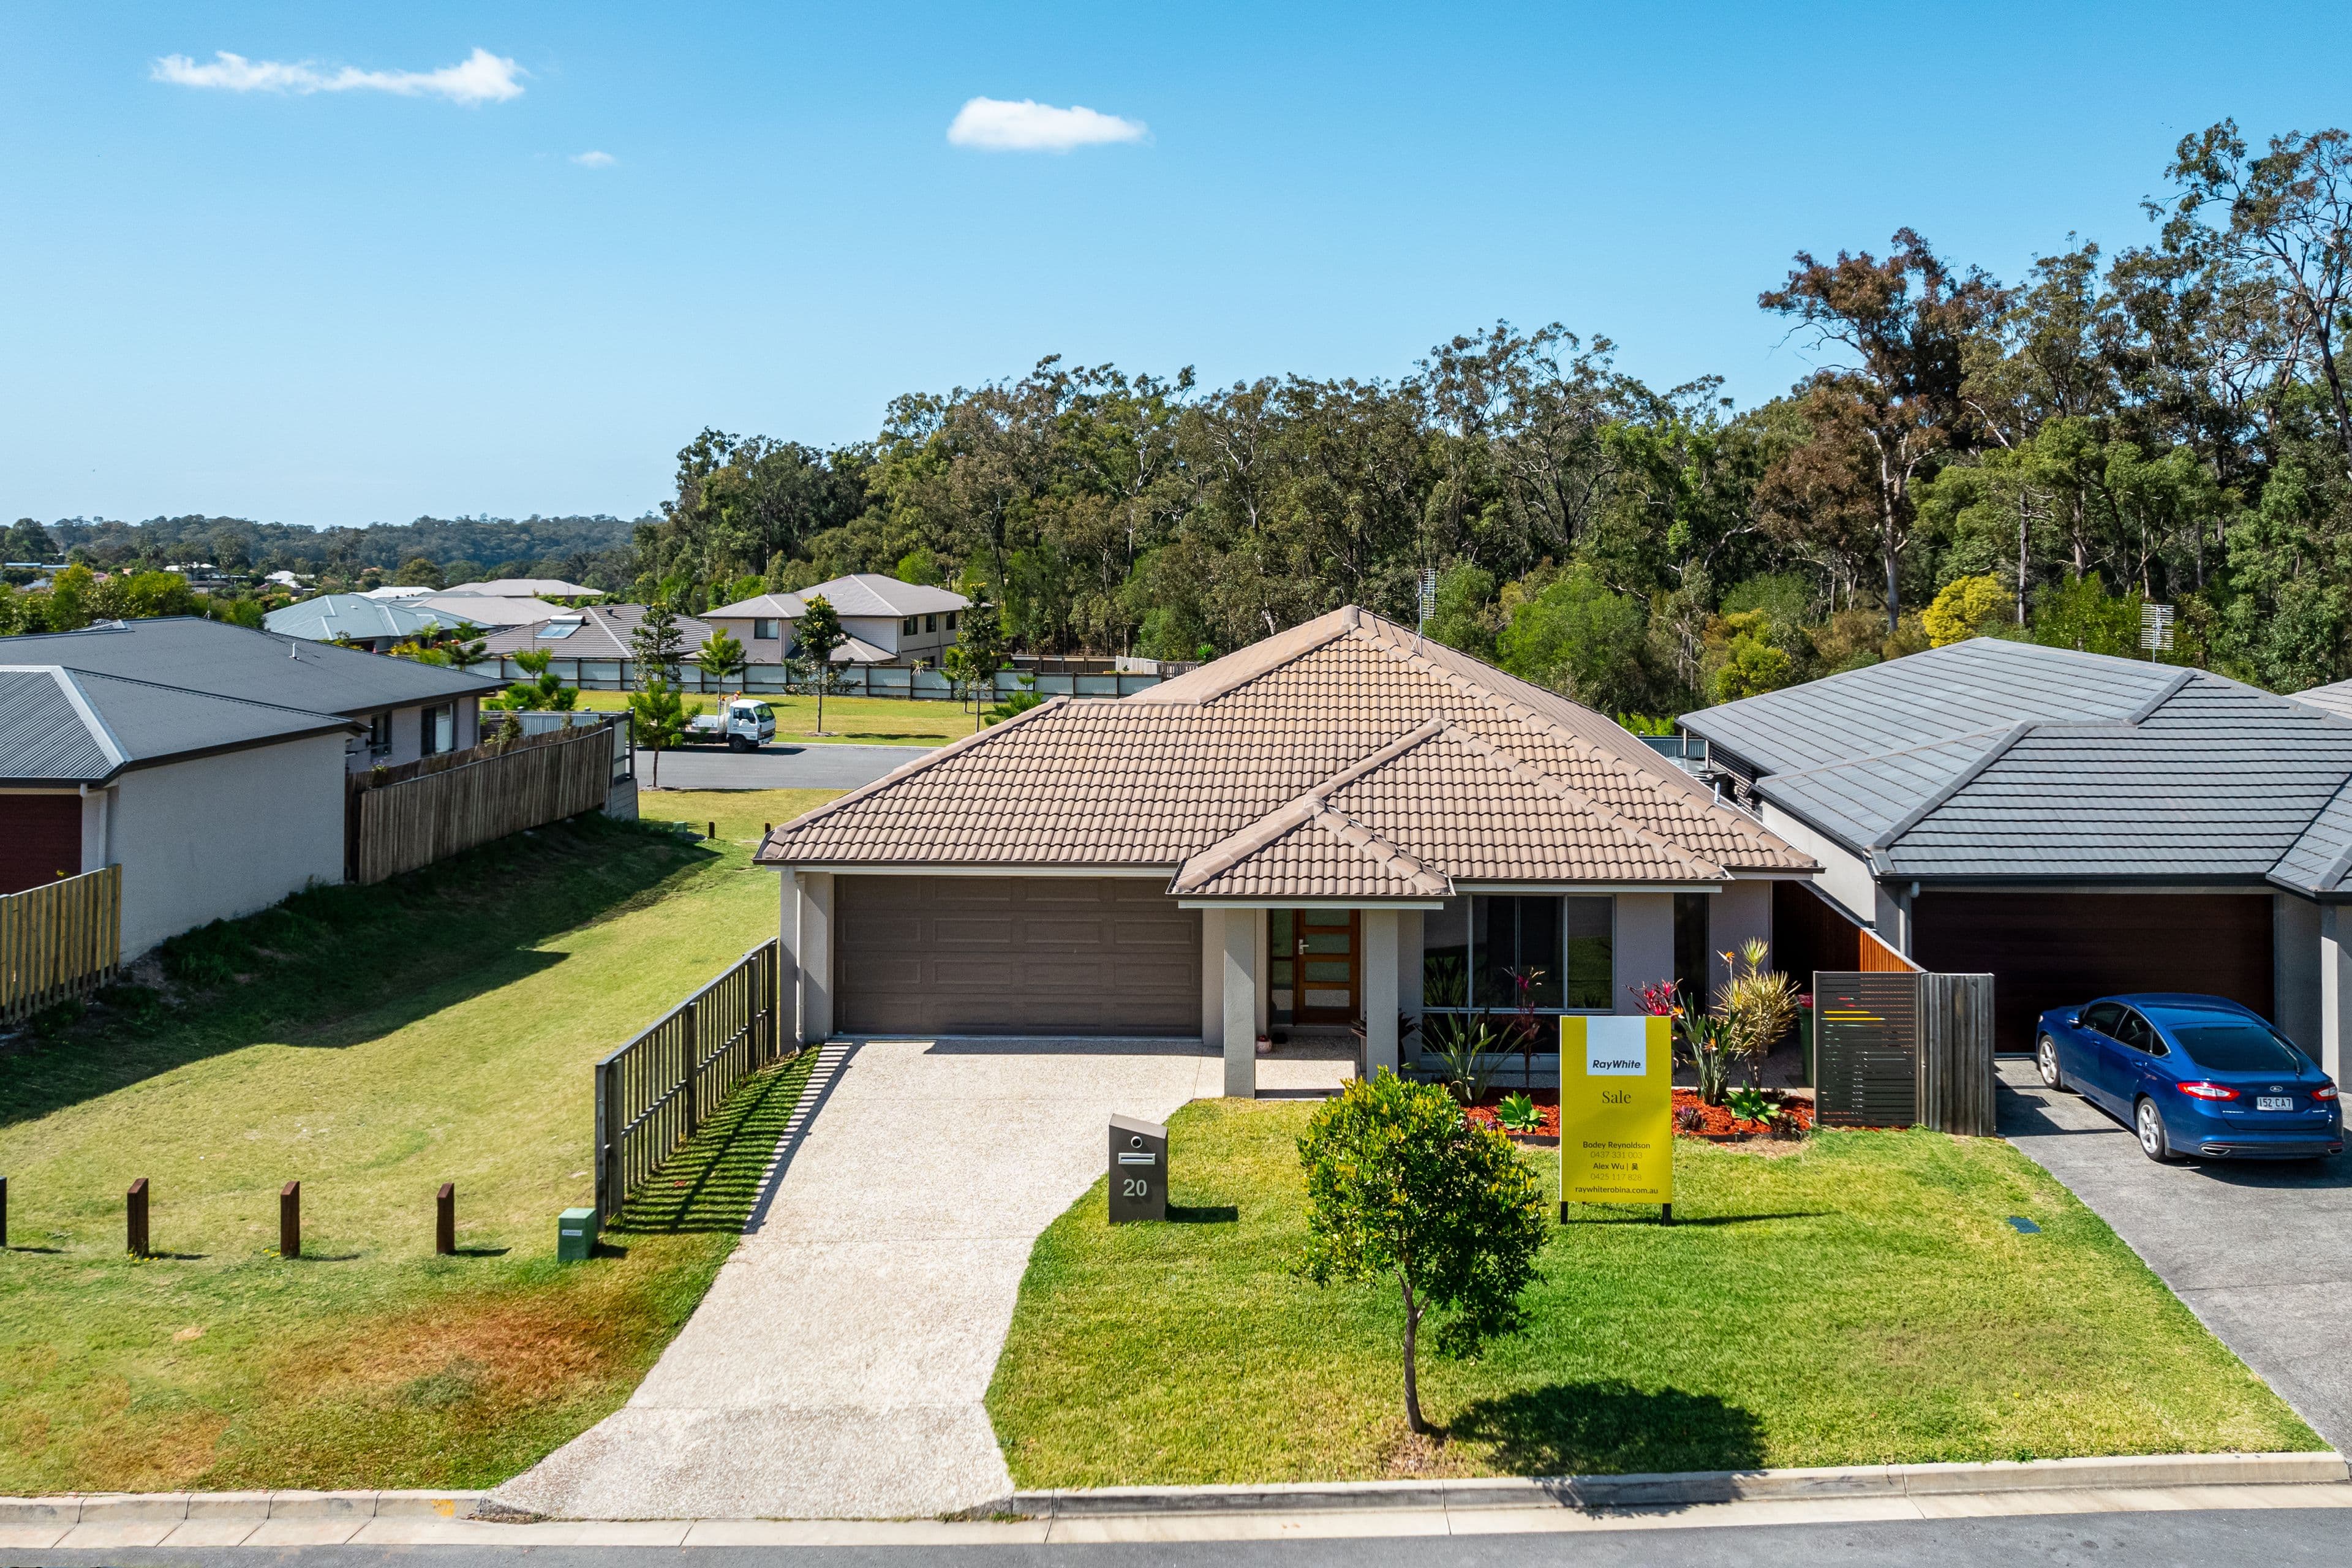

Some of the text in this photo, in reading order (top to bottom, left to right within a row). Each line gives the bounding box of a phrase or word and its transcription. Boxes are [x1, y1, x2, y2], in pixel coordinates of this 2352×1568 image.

[1602, 1090, 1632, 1104] Sale
[1123, 1178, 1147, 1196] 20
[1575, 1186, 1658, 1194] raywhiterobina.com.au
